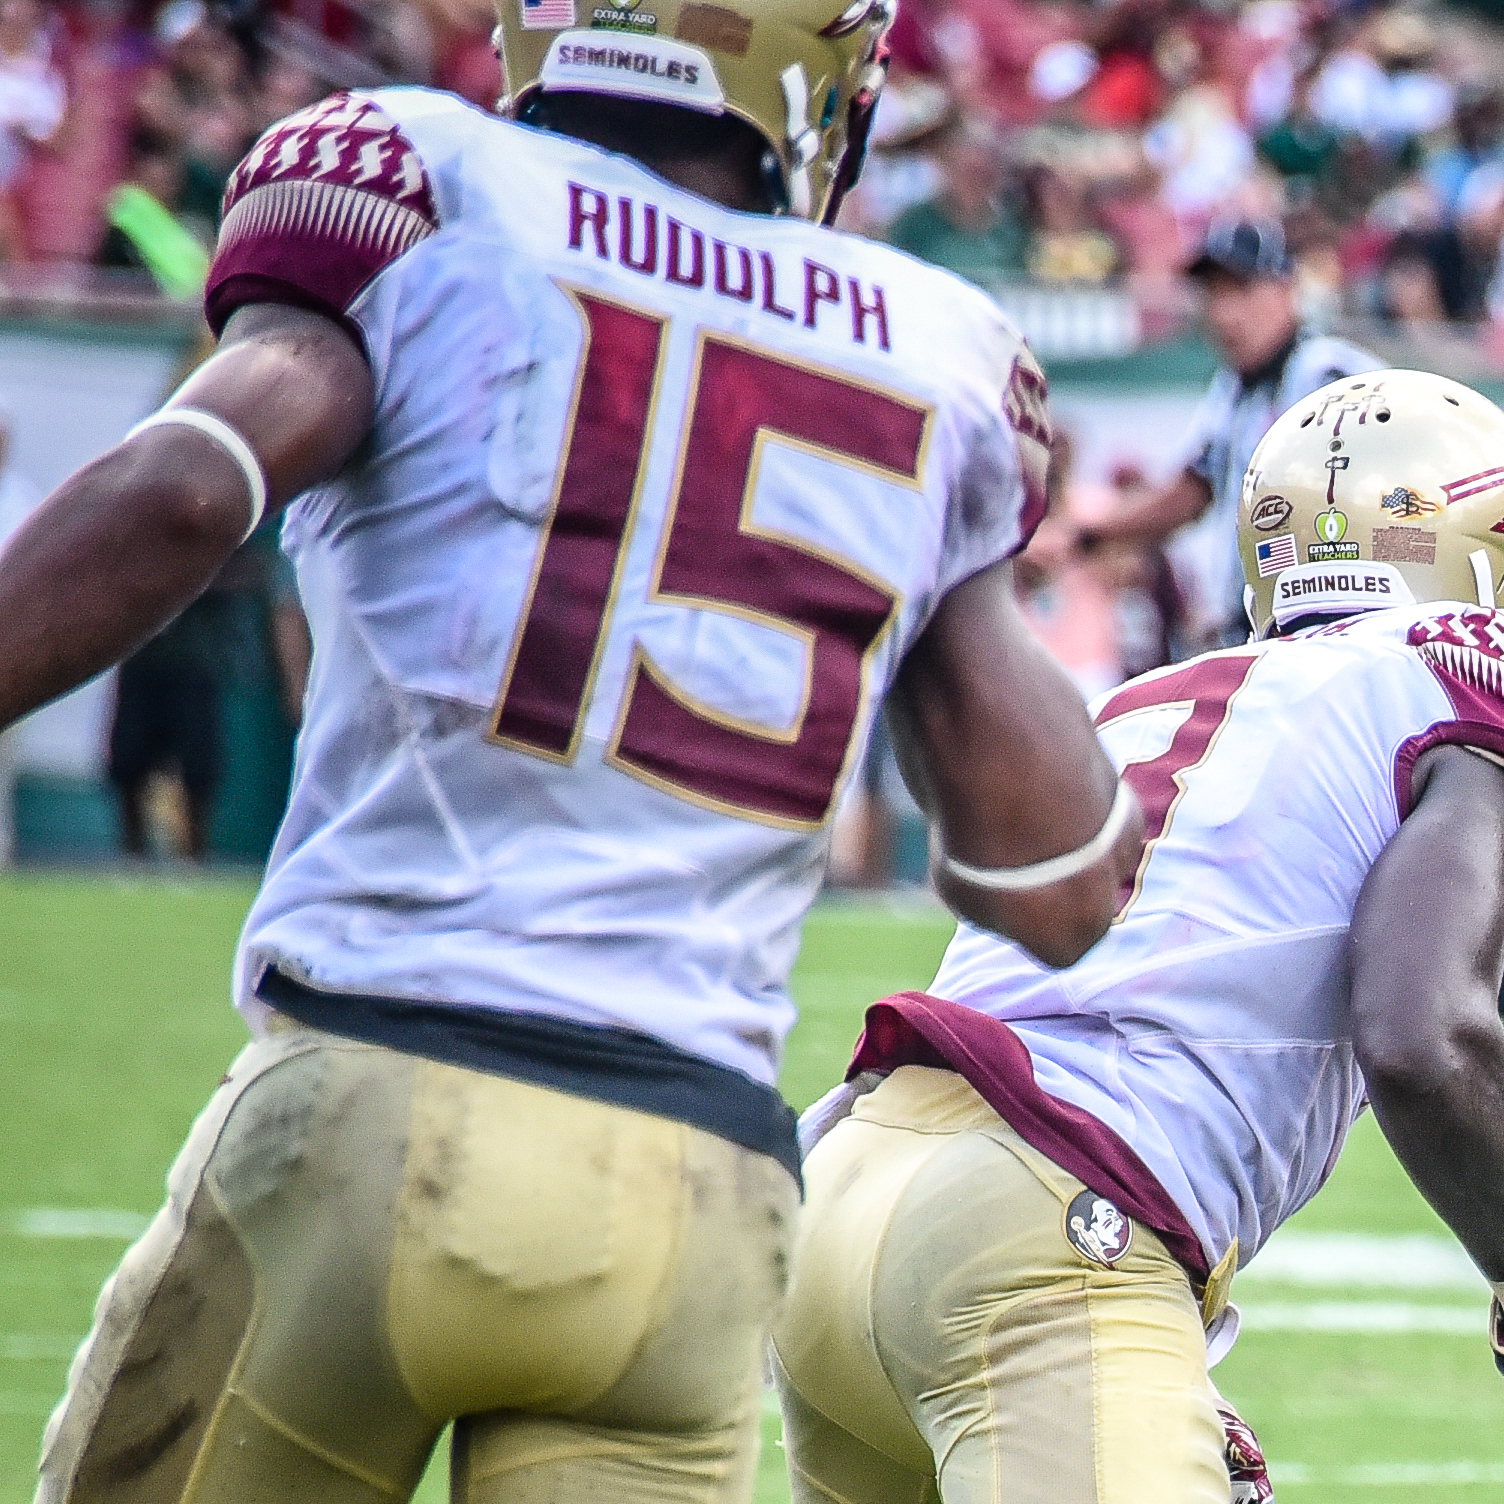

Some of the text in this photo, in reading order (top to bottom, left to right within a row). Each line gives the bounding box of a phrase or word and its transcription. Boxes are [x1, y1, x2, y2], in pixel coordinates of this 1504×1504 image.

[594, 9, 657, 24] EXTRA YARD
[559, 45, 700, 85] SEMINOLES
[567, 180, 891, 352] RUDOLPH
[1257, 501, 1285, 518] ACC
[487, 274, 936, 832] 15
[1309, 543, 1358, 554] EXTRA YARD
[1280, 575, 1391, 598] SEMINOLES
